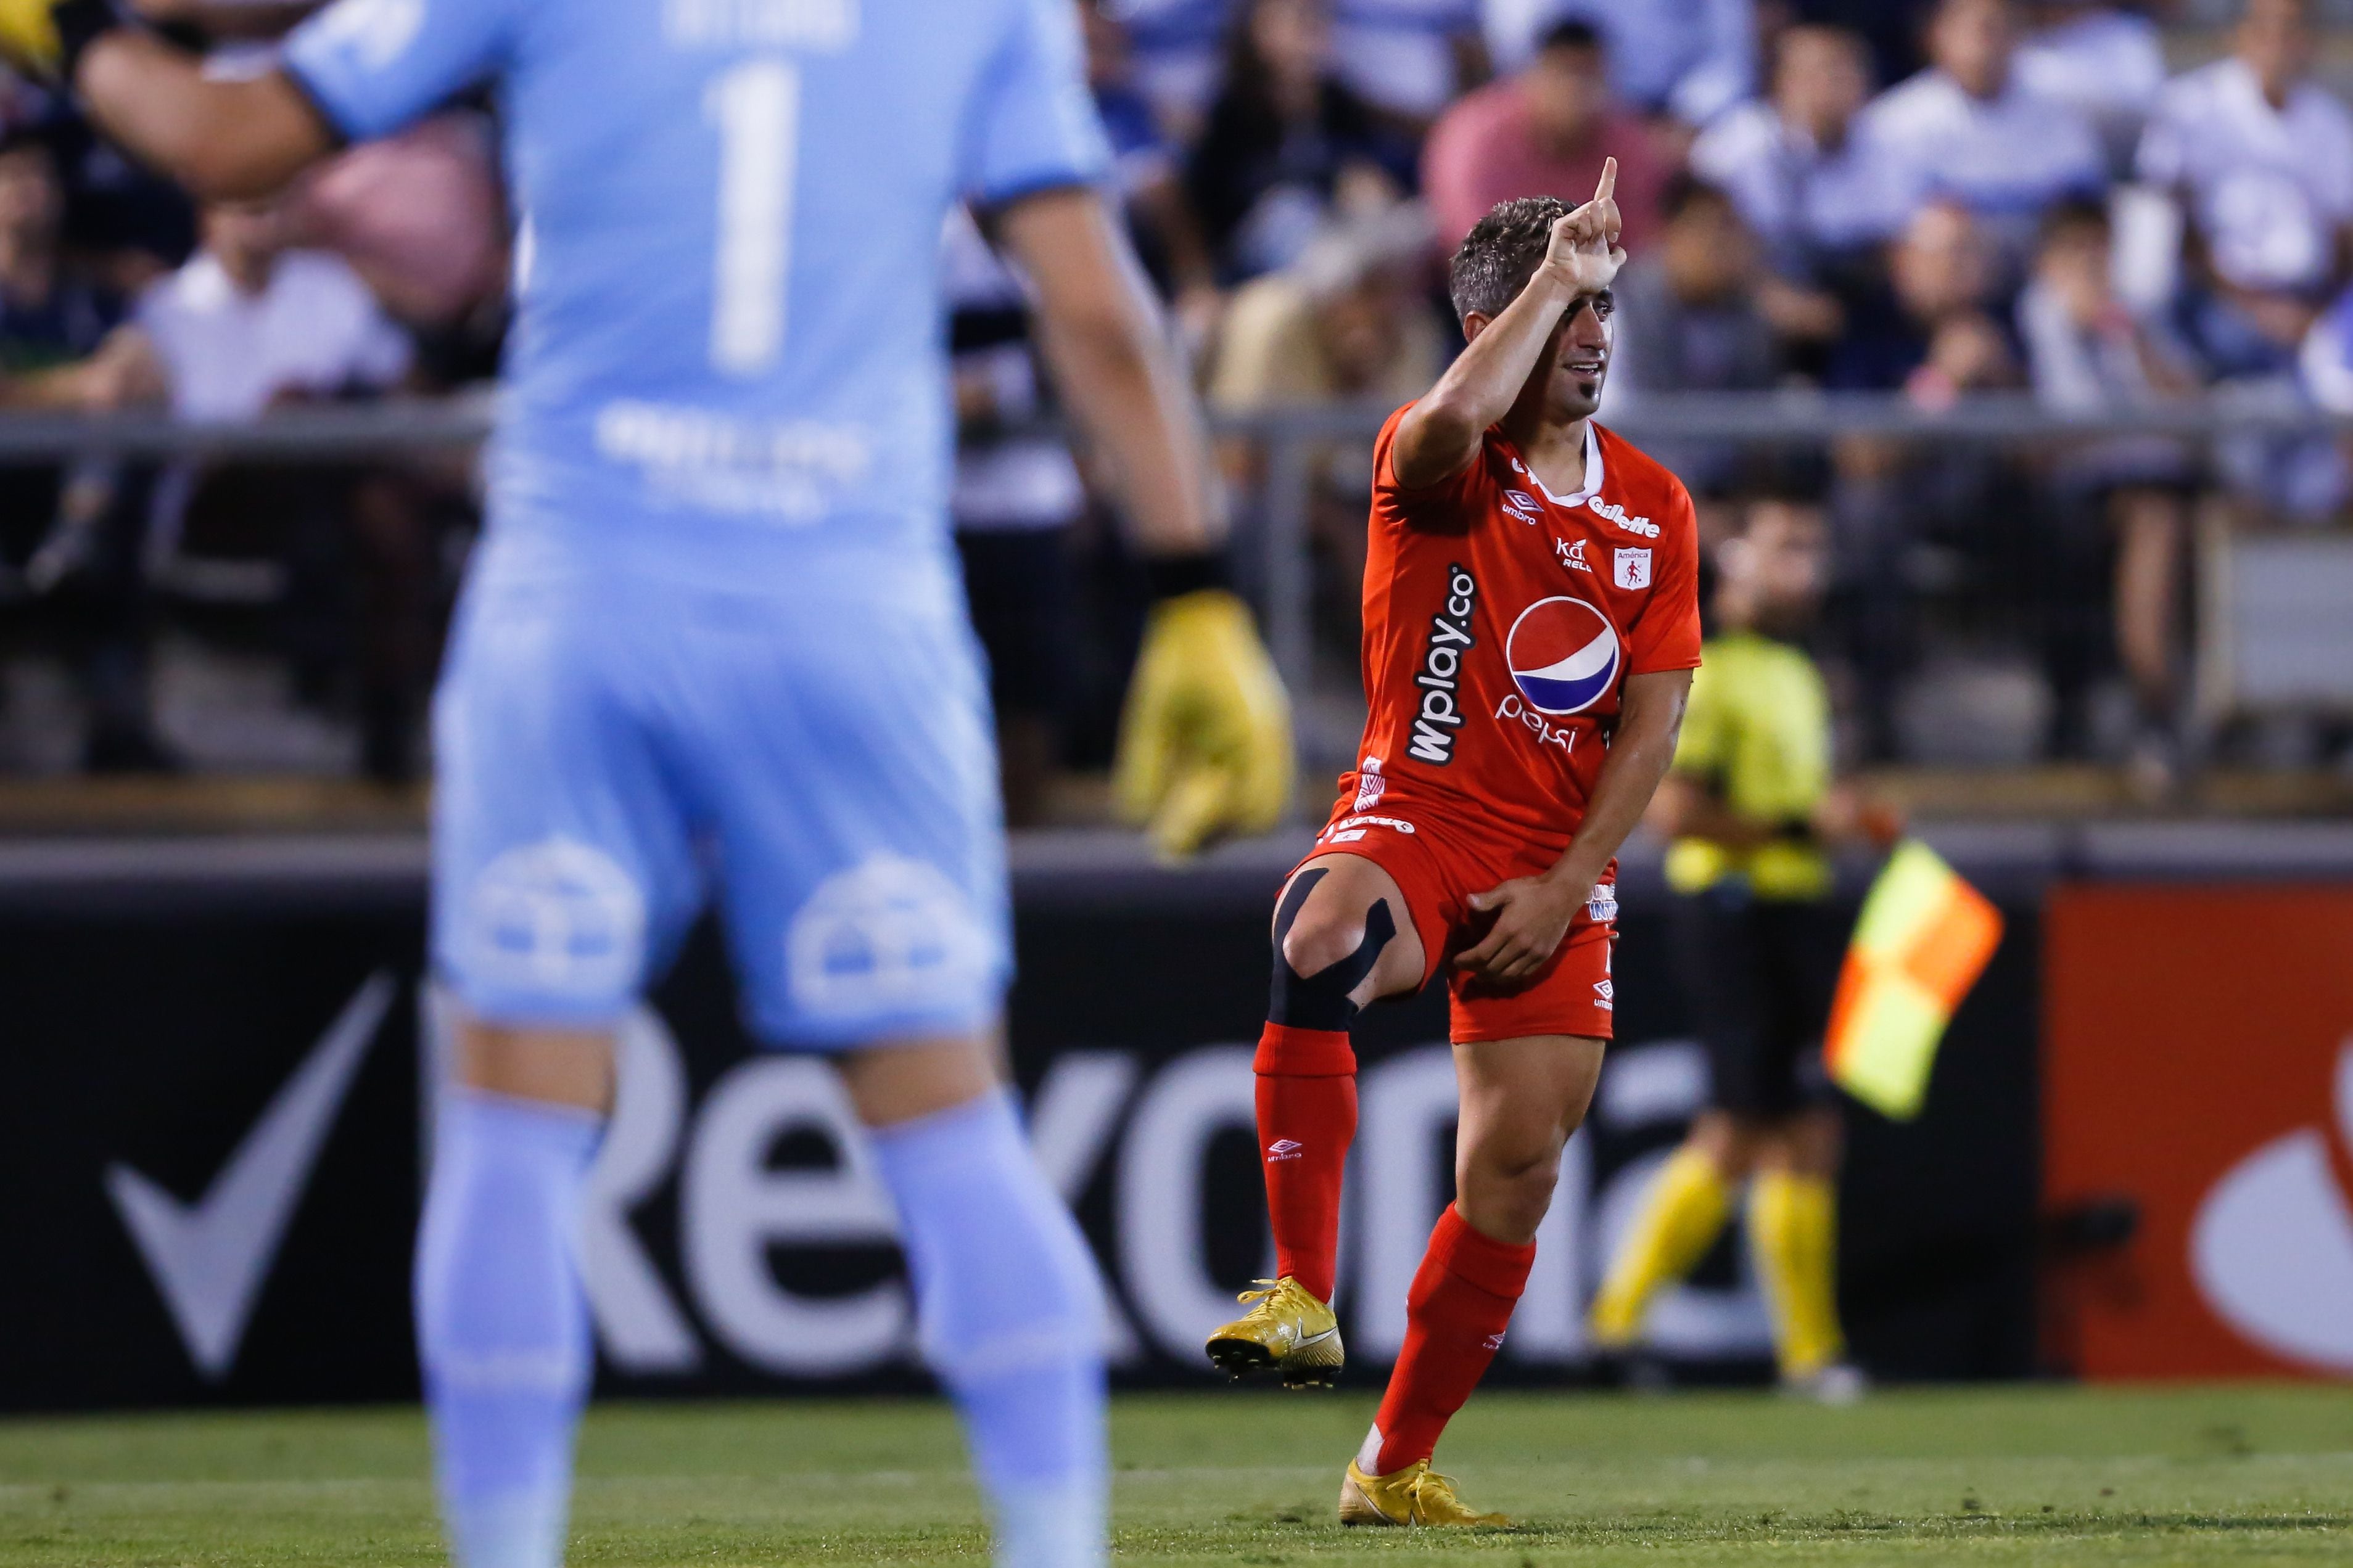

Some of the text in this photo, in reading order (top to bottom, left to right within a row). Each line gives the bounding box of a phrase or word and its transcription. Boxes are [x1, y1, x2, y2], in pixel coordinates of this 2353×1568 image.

[704, 60, 799, 374] 1
[1502, 503, 1537, 525] umbro
[1588, 495, 1661, 539] Gillette
